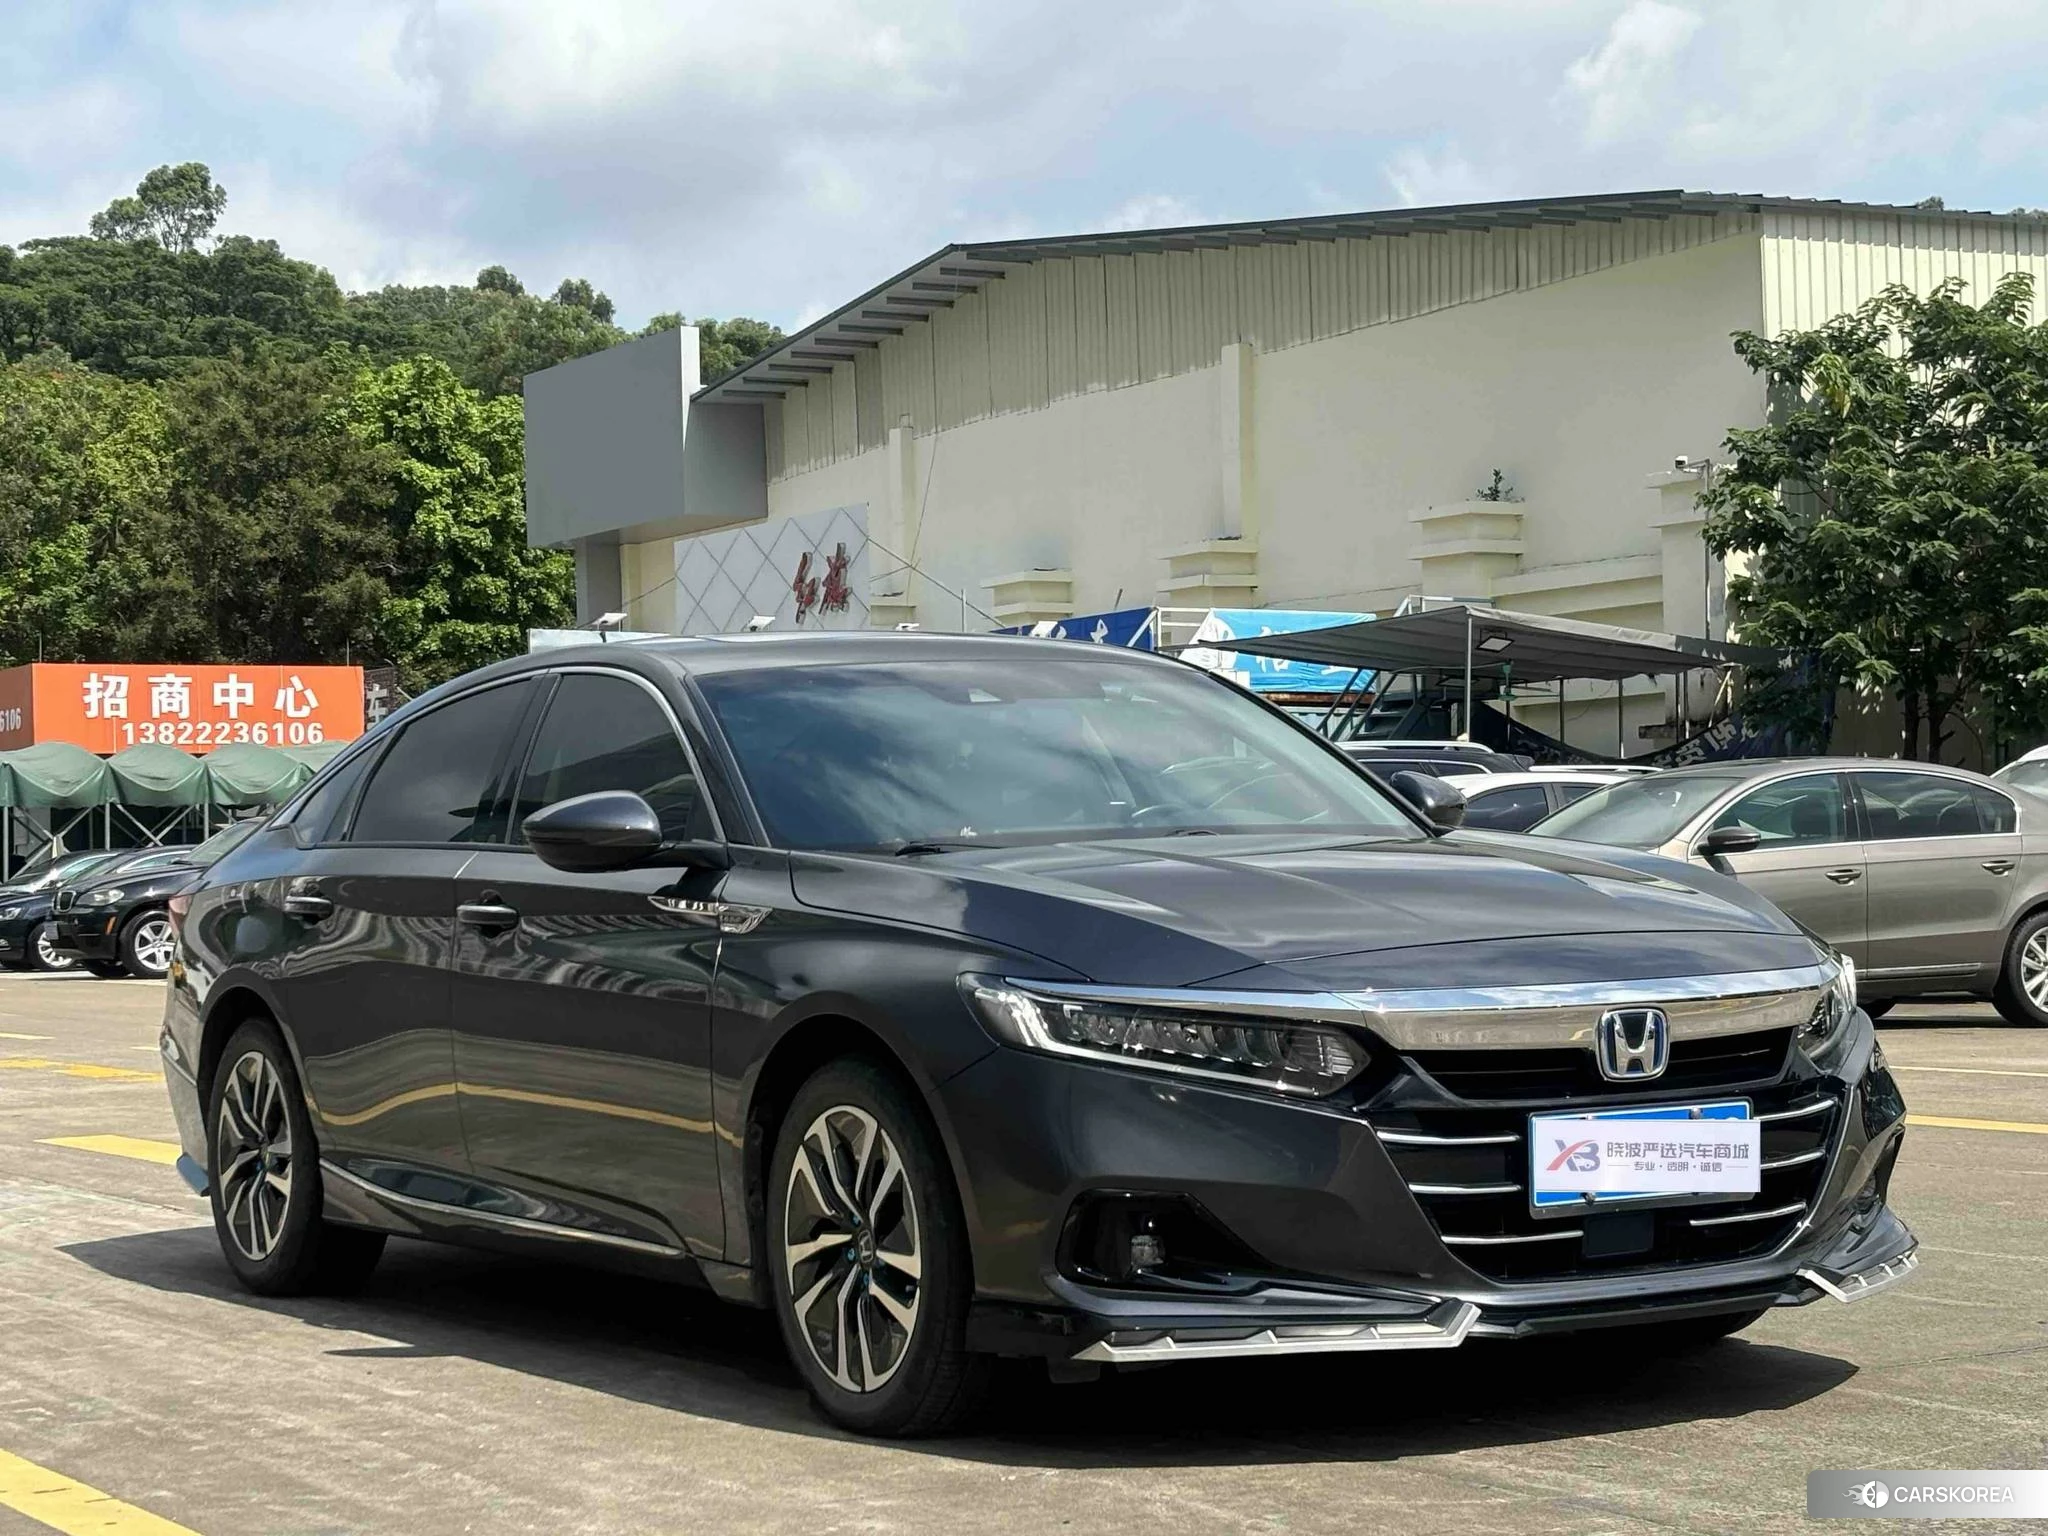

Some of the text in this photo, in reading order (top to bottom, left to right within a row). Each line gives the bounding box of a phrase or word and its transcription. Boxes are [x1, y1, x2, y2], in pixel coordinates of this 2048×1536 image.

[81, 671, 320, 720] 招商中心
[121, 721, 325, 746] 13822236106
[1606, 1142, 1749, 1160] 晓波严选汽车商城
